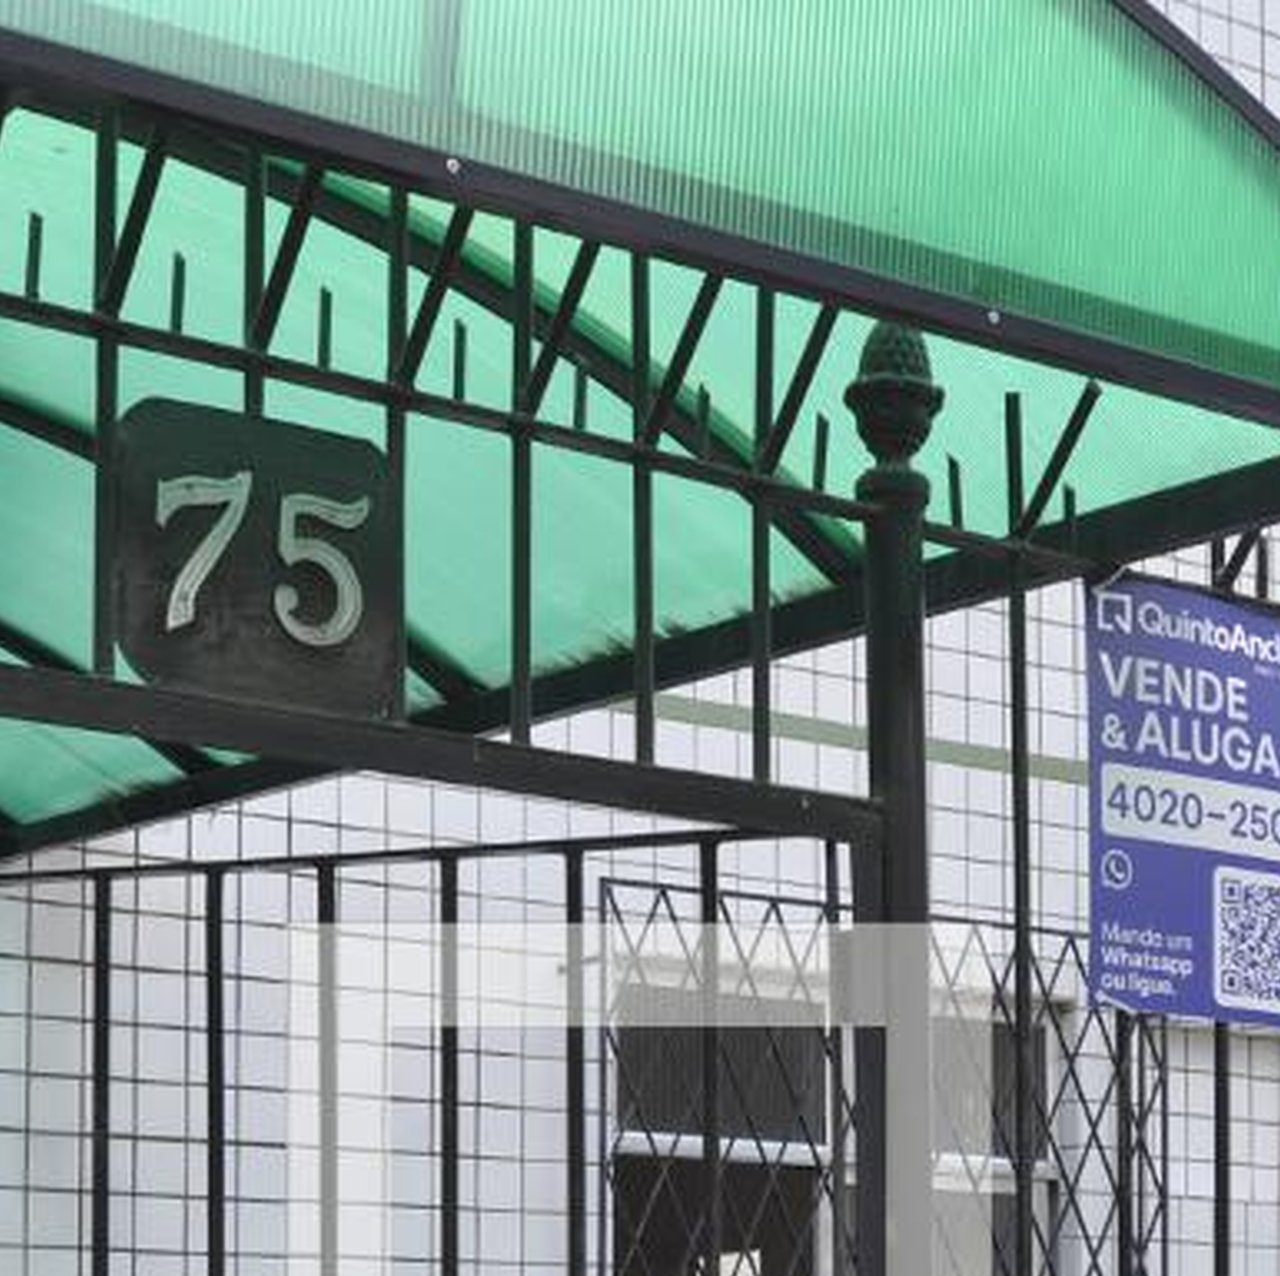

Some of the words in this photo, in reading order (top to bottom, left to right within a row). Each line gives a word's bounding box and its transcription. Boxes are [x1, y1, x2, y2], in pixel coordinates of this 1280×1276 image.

[156, 471, 370, 646] 75
[1099, 652, 1249, 722] VENDE
[1101, 713, 1128, 750] &
[1101, 972, 1126, 991] ou
